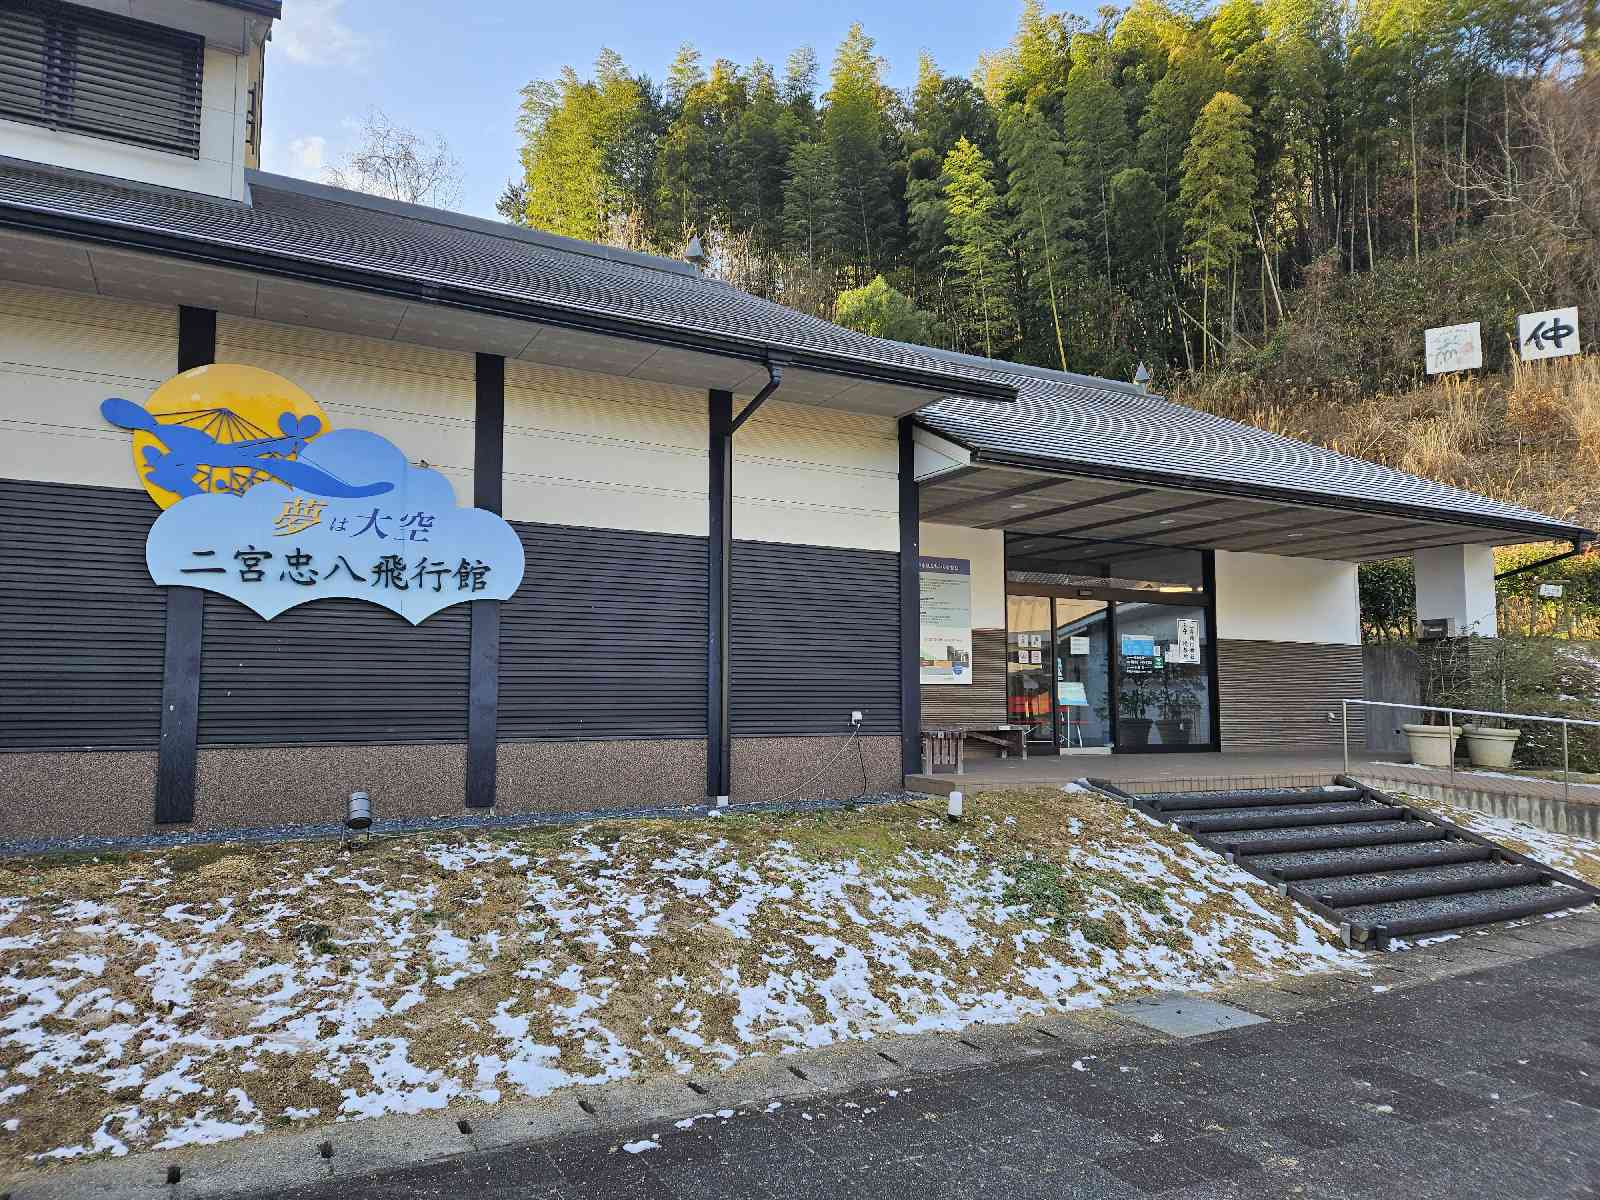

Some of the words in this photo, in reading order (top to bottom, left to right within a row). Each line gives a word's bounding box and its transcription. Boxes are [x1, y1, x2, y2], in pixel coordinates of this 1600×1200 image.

[1524, 317, 1575, 351] 仲
[272, 496, 435, 543] 夢は大空
[179, 545, 492, 593] 二宮忠八飛行館
